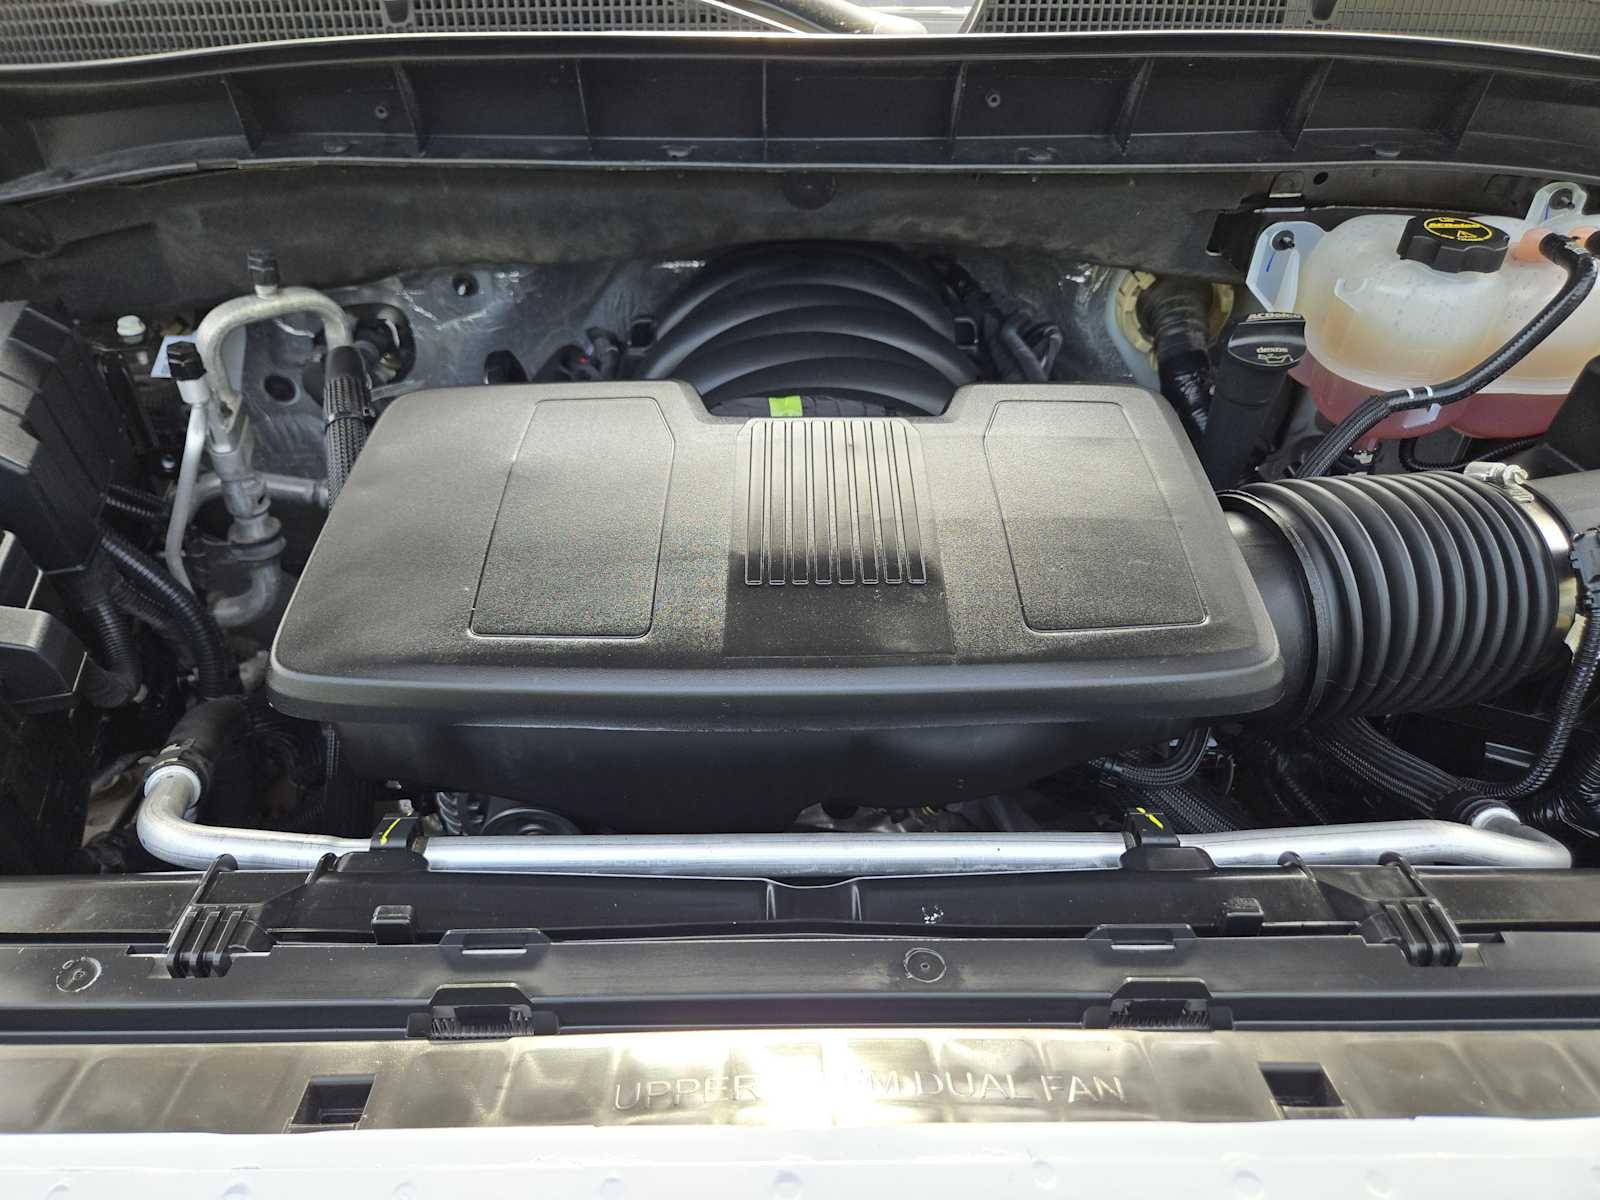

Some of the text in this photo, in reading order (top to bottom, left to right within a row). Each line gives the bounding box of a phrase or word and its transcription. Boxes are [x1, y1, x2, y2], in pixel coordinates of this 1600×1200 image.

[614, 1073, 763, 1110] UPPER
[914, 1071, 1033, 1098] DUAL
[1040, 1074, 1126, 1103] FAN
